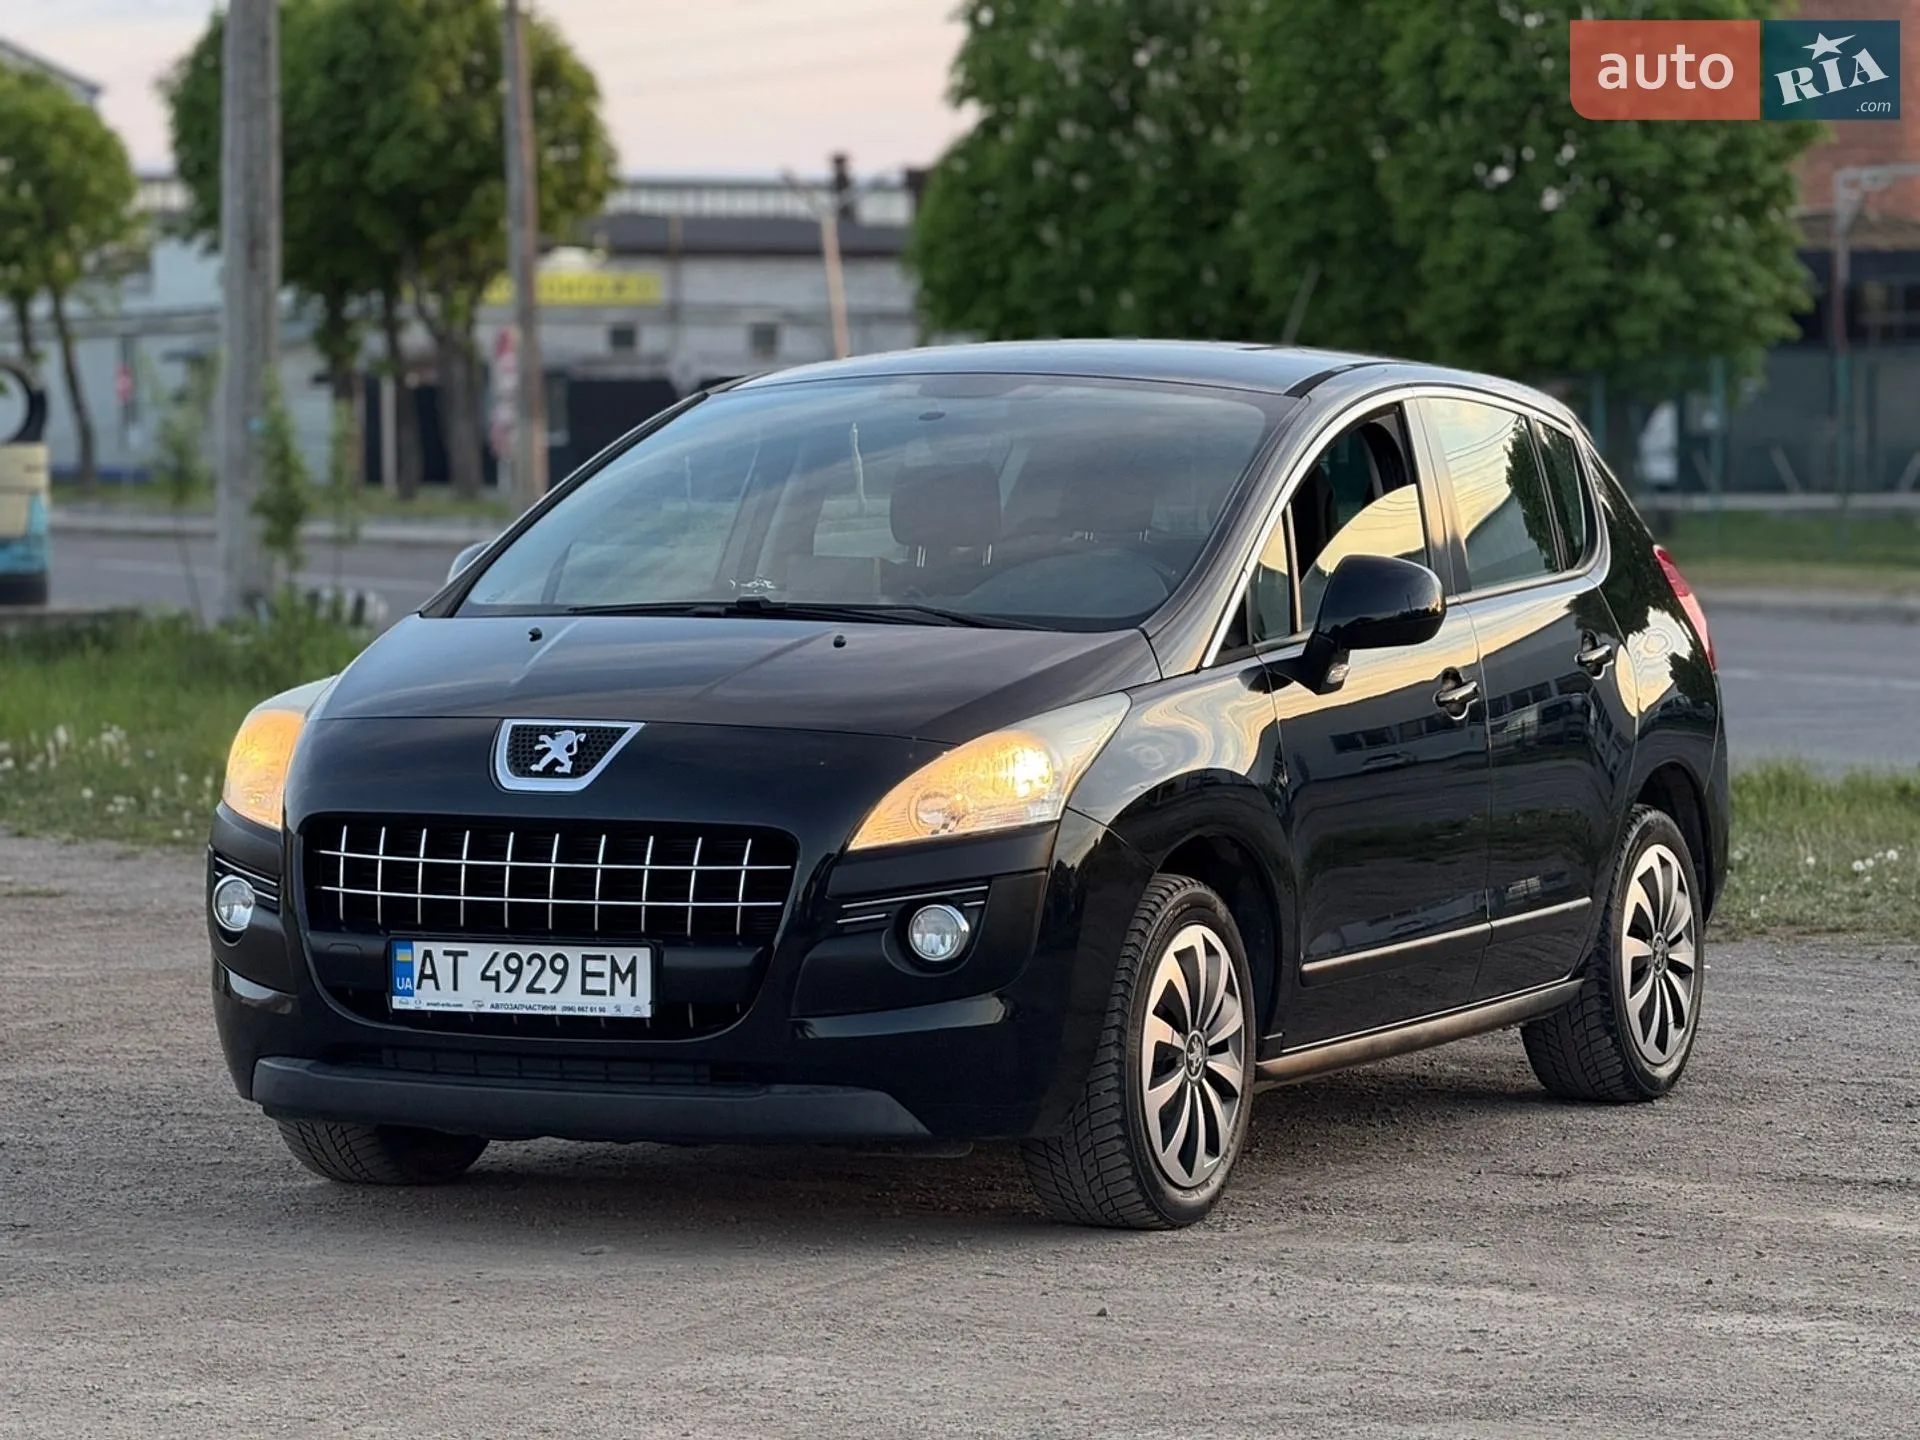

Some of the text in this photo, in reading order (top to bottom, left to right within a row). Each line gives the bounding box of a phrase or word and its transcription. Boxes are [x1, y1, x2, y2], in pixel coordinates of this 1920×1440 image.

[396, 977, 413, 990] UA
[416, 949, 638, 997] AT 4929 EM
